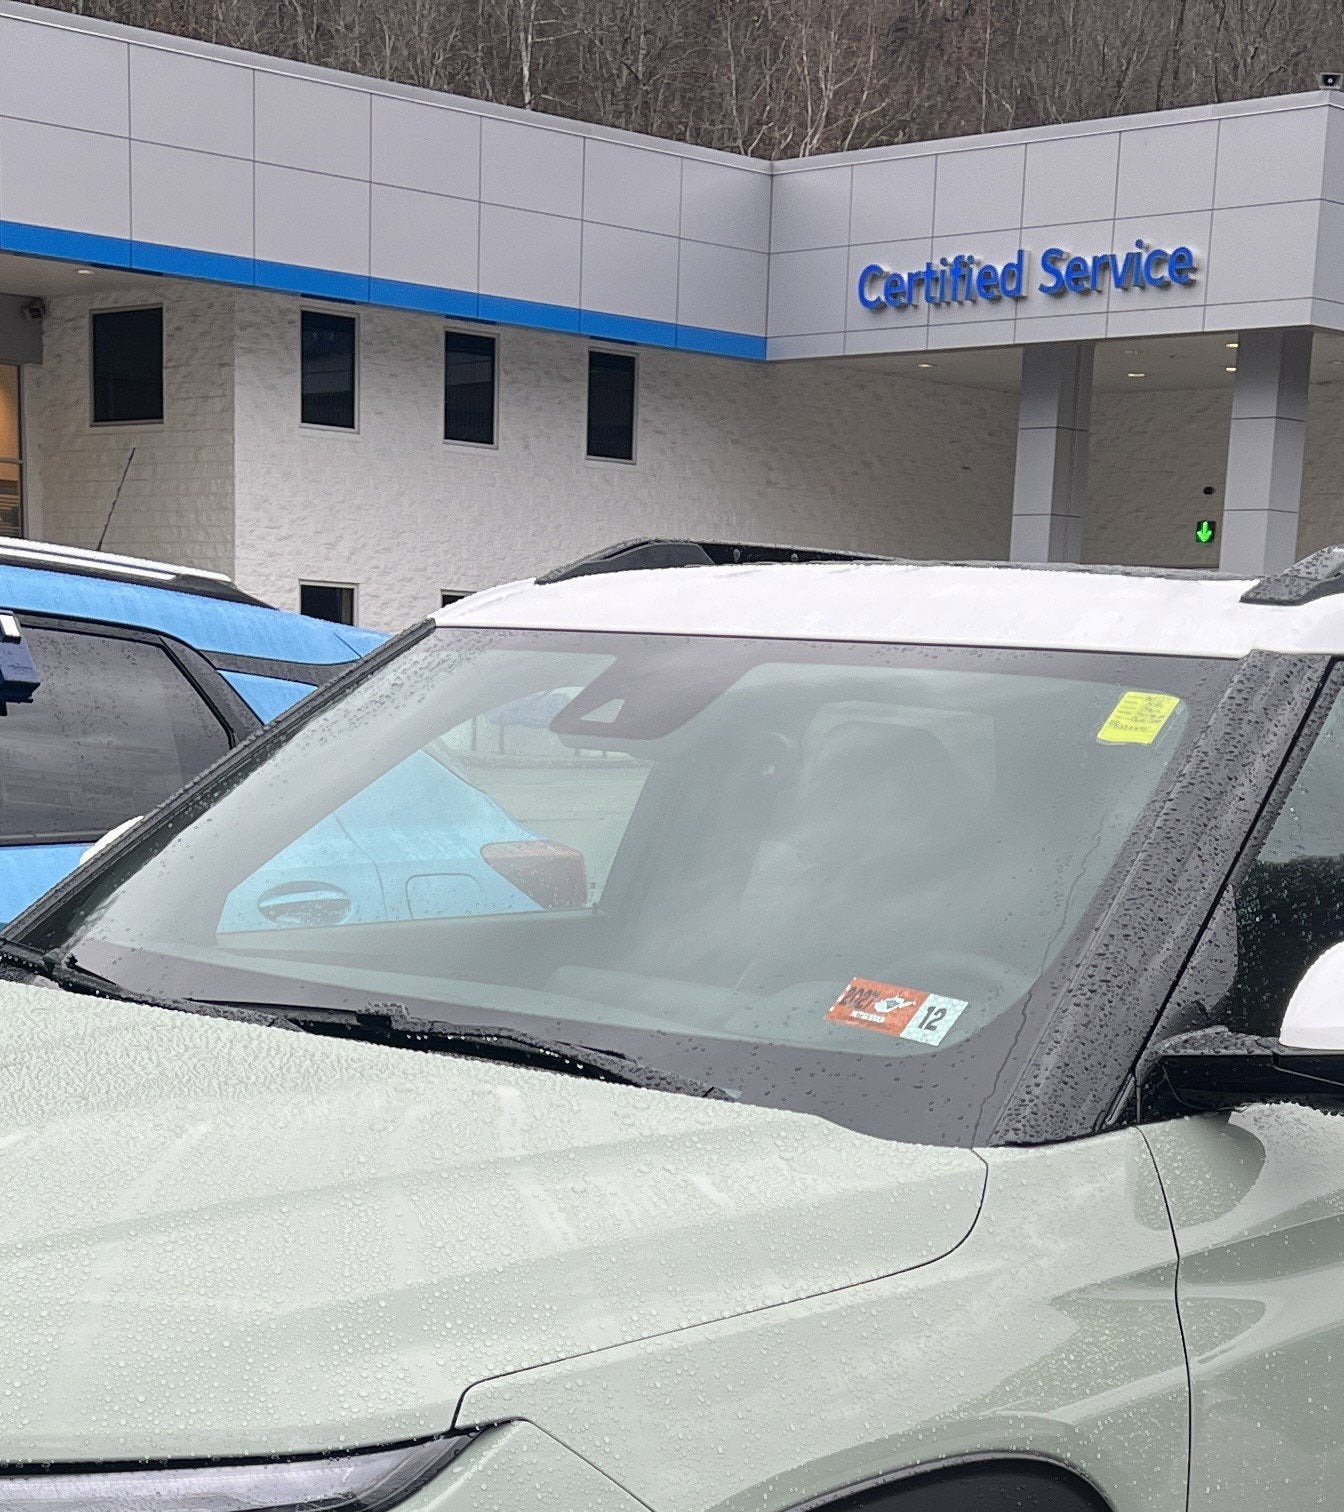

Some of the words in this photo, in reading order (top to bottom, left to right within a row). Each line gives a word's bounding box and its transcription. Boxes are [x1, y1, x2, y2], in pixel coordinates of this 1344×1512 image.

[857, 248, 1028, 311] Certified
[1038, 239, 1196, 296] Service
[918, 1005, 948, 1031] 12
